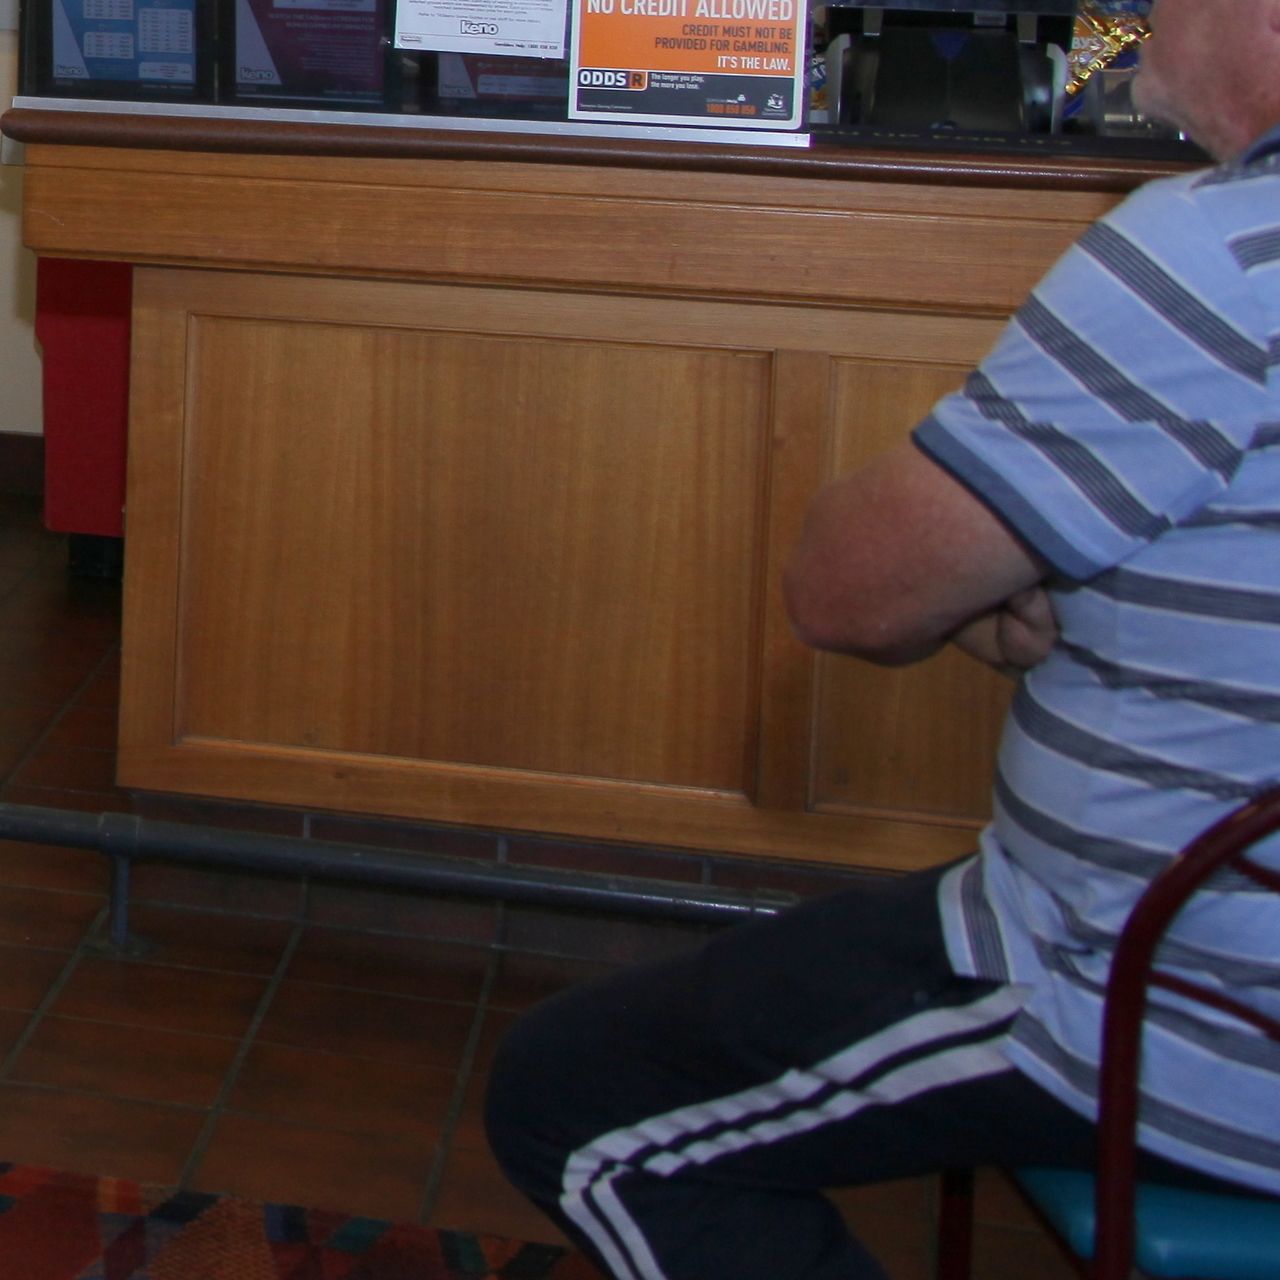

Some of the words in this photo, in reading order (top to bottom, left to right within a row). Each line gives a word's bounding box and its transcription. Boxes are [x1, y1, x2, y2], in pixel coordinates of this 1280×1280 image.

[460, 20, 498, 35] keno
[682, 24, 719, 37] CREDIT
[723, 26, 751, 38] MUST
[755, 27, 776, 39] NOT
[779, 28, 793, 39] BE
[655, 37, 707, 51] PROVIDED
[710, 39, 730, 51] FOR
[733, 40, 791, 53] GAMBLING.
[717, 55, 737, 68] IT'S
[740, 56, 761, 69] THE
[763, 57, 791, 71] LAW.
[579, 71, 627, 86] ODDS
[632, 73, 643, 86] R
[651, 73, 661, 81] The
[662, 73, 679, 82] longer
[680, 74, 690, 82] you
[692, 74, 705, 83] play,
[651, 81, 659, 89] the
[676, 82, 686, 90] you
